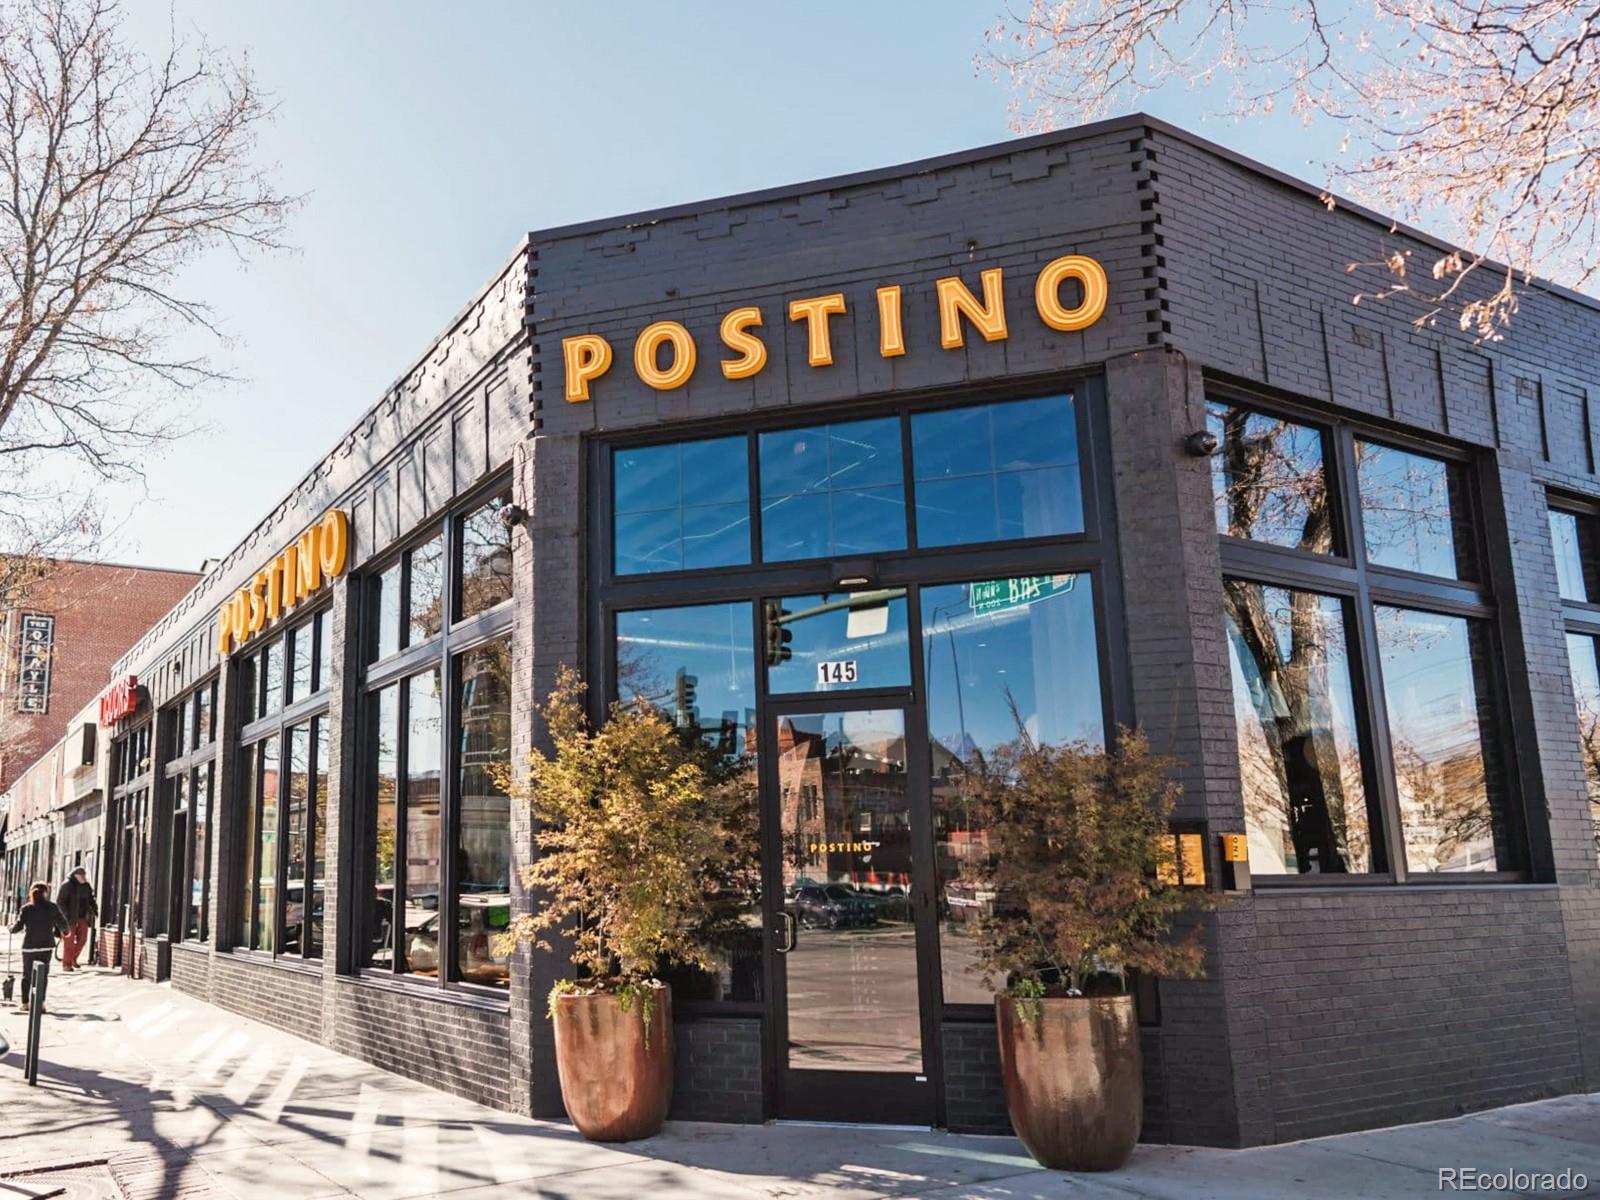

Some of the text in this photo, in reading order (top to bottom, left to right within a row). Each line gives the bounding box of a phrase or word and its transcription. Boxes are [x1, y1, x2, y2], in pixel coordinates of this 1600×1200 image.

[562, 254, 1109, 404] POSTINO
[218, 509, 347, 654] POSTINO
[820, 661, 856, 682] 145
[809, 841, 873, 856] POSTINO
